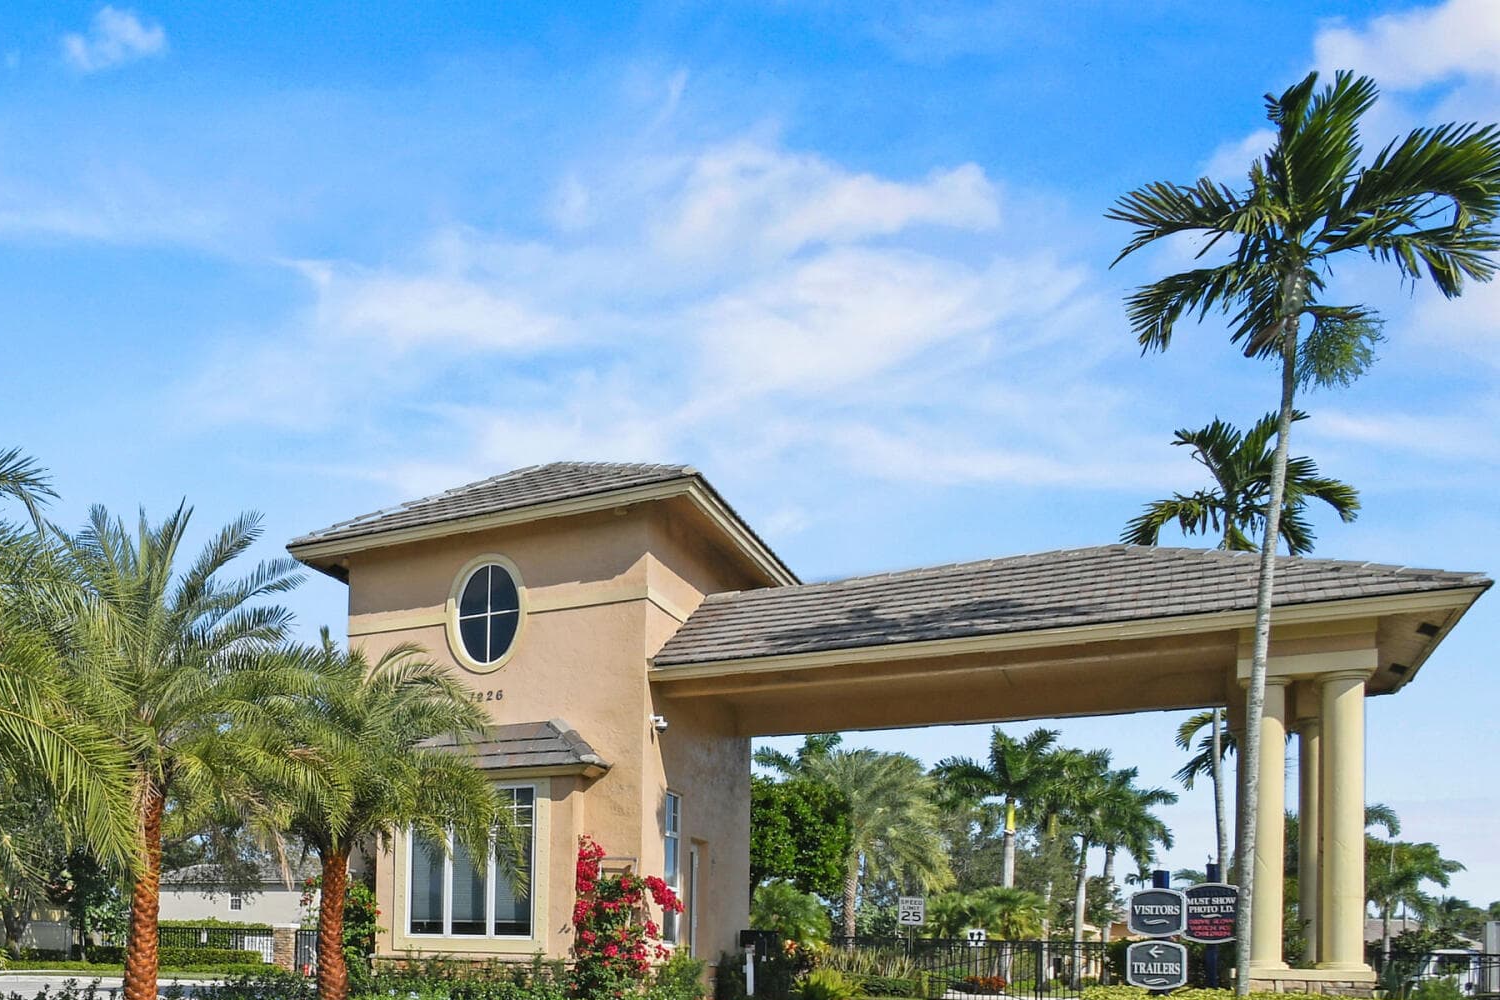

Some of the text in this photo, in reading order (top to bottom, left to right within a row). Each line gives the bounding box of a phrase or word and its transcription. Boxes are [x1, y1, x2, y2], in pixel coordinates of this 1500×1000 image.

[1187, 897, 1210, 905] MUST
[1134, 905, 1180, 915] VISITORS
[1189, 905, 1235, 913] PHOTO I.D.
[901, 911, 921, 921] 25
[1132, 962, 1181, 975] TRAILERS
